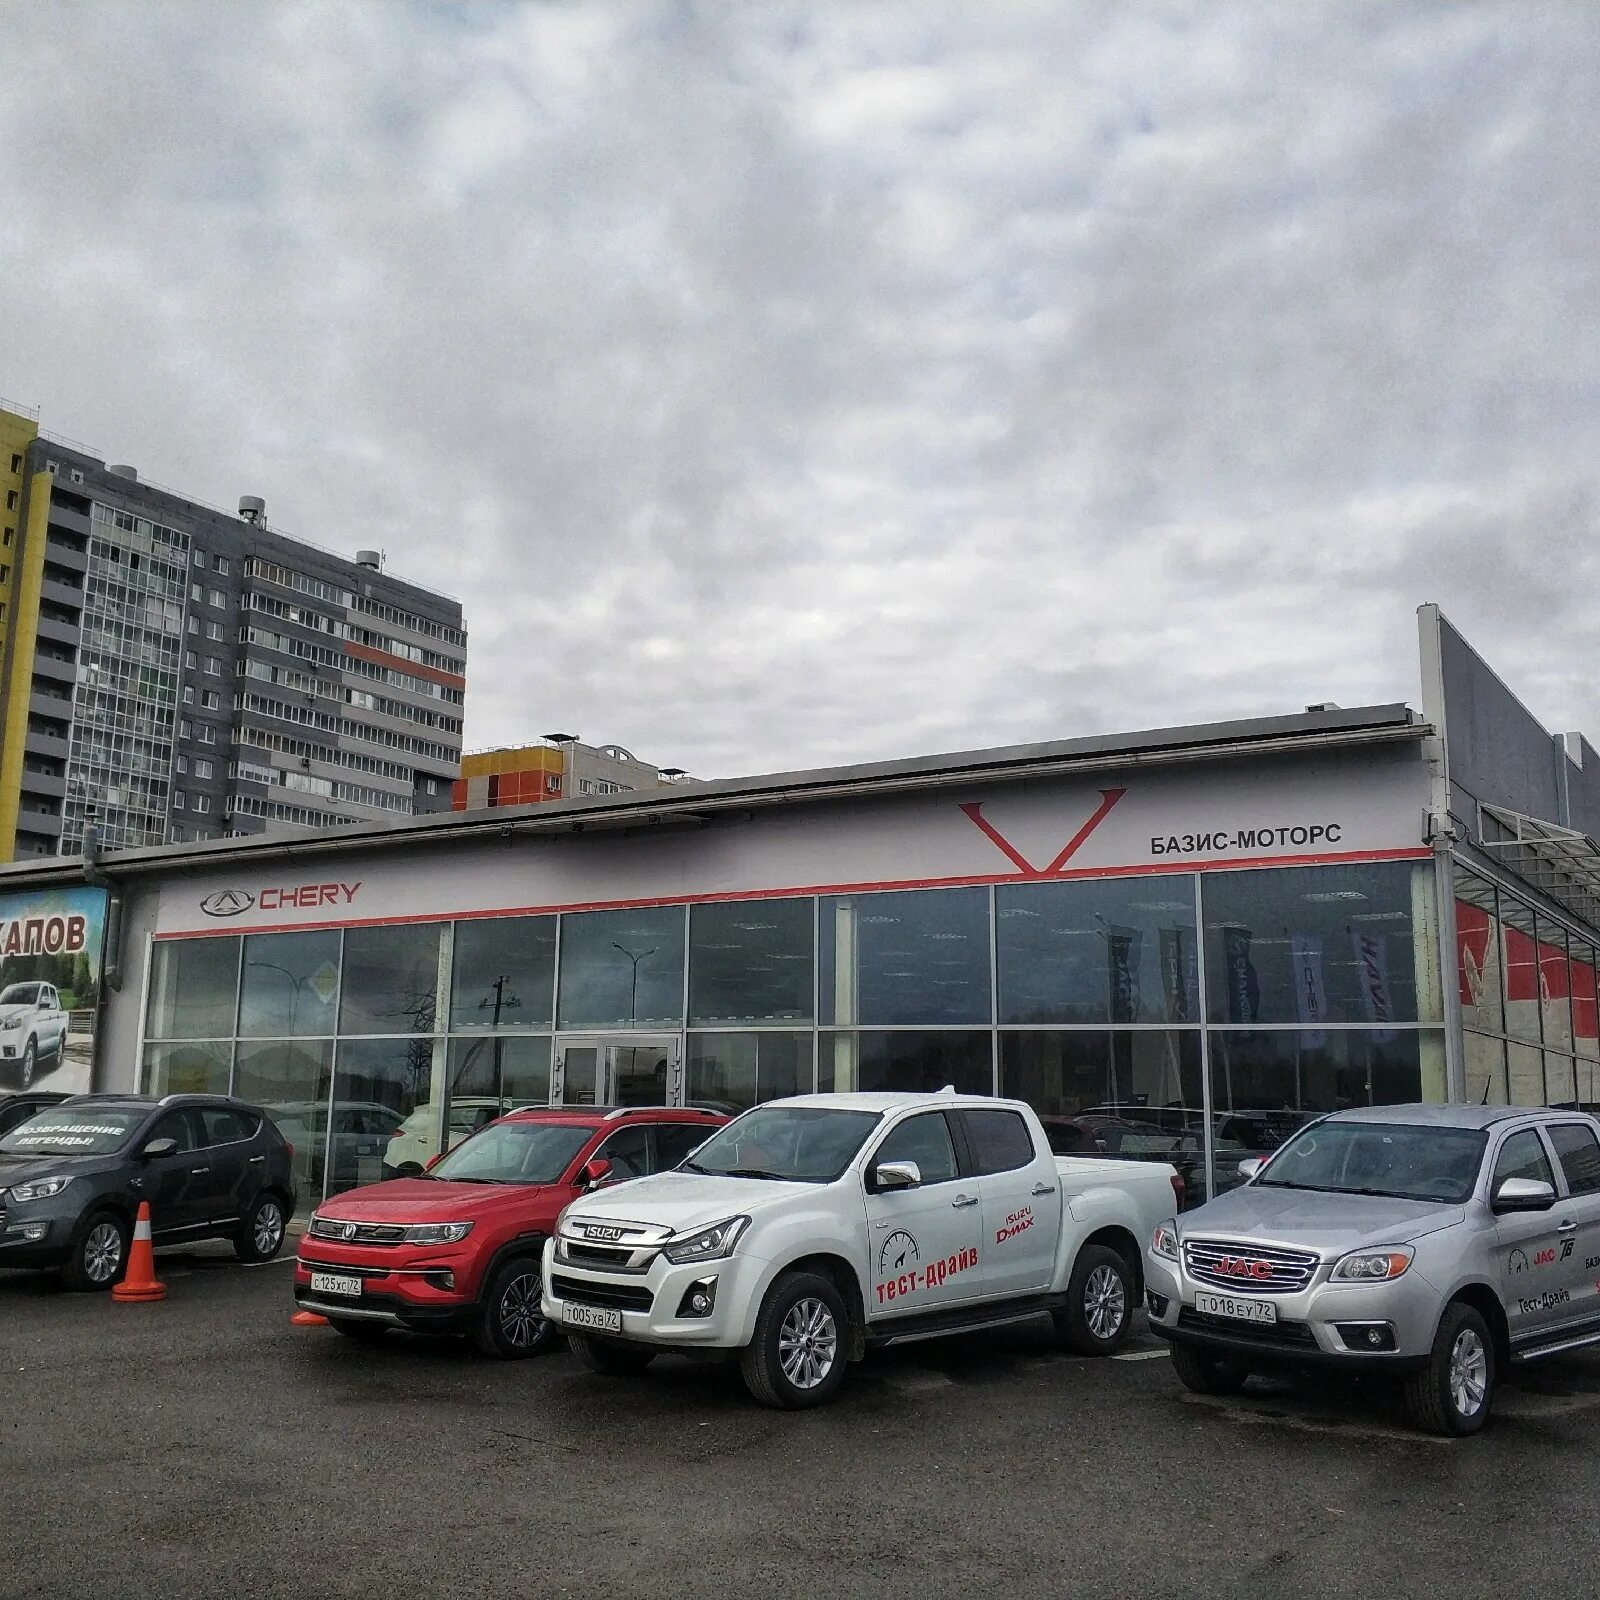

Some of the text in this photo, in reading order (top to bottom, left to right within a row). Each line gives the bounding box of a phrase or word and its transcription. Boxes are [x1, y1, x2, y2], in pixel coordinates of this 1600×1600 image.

[1151, 823, 1342, 854] БАЗИС-МОТОРС
[259, 882, 362, 910] CHERY
[1005, 1205, 1032, 1225] ISUZU
[586, 1226, 621, 1239] ISUZU
[1211, 1256, 1274, 1279] JAC
[1534, 1248, 1555, 1265] JAC
[876, 1246, 978, 1304] тест-драйв
